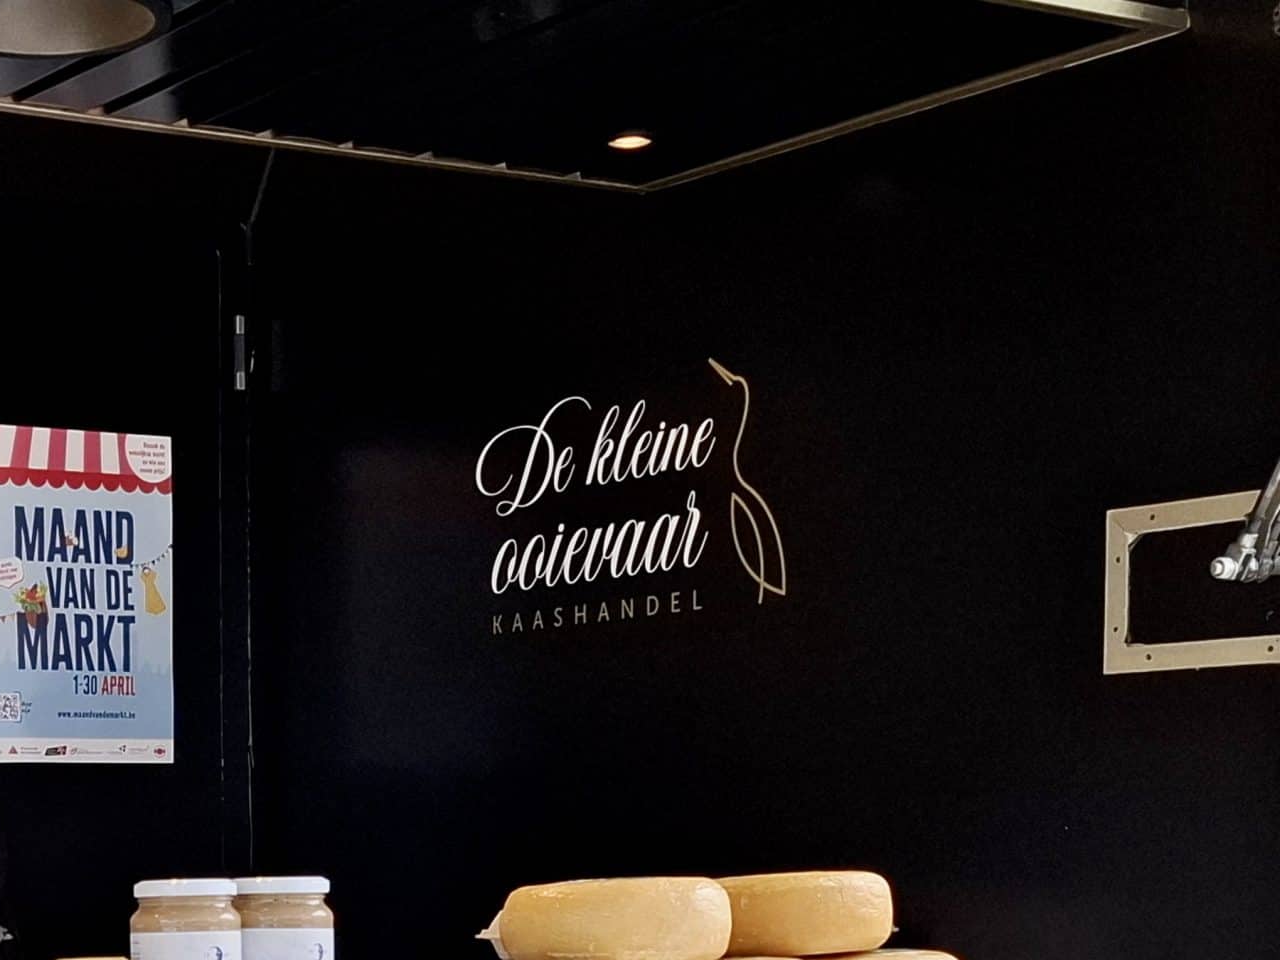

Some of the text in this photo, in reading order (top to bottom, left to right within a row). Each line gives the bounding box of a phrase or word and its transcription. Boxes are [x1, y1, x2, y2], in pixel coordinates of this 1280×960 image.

[475, 395, 717, 517] De kleine
[14, 505, 135, 565] MAAND
[490, 490, 710, 595] ooievaar
[46, 566, 96, 610] VAN
[105, 569, 136, 611] DE
[492, 589, 705, 635] KAASHANDEL
[16, 612, 136, 673] MARKT
[101, 676, 136, 696] APRIL
